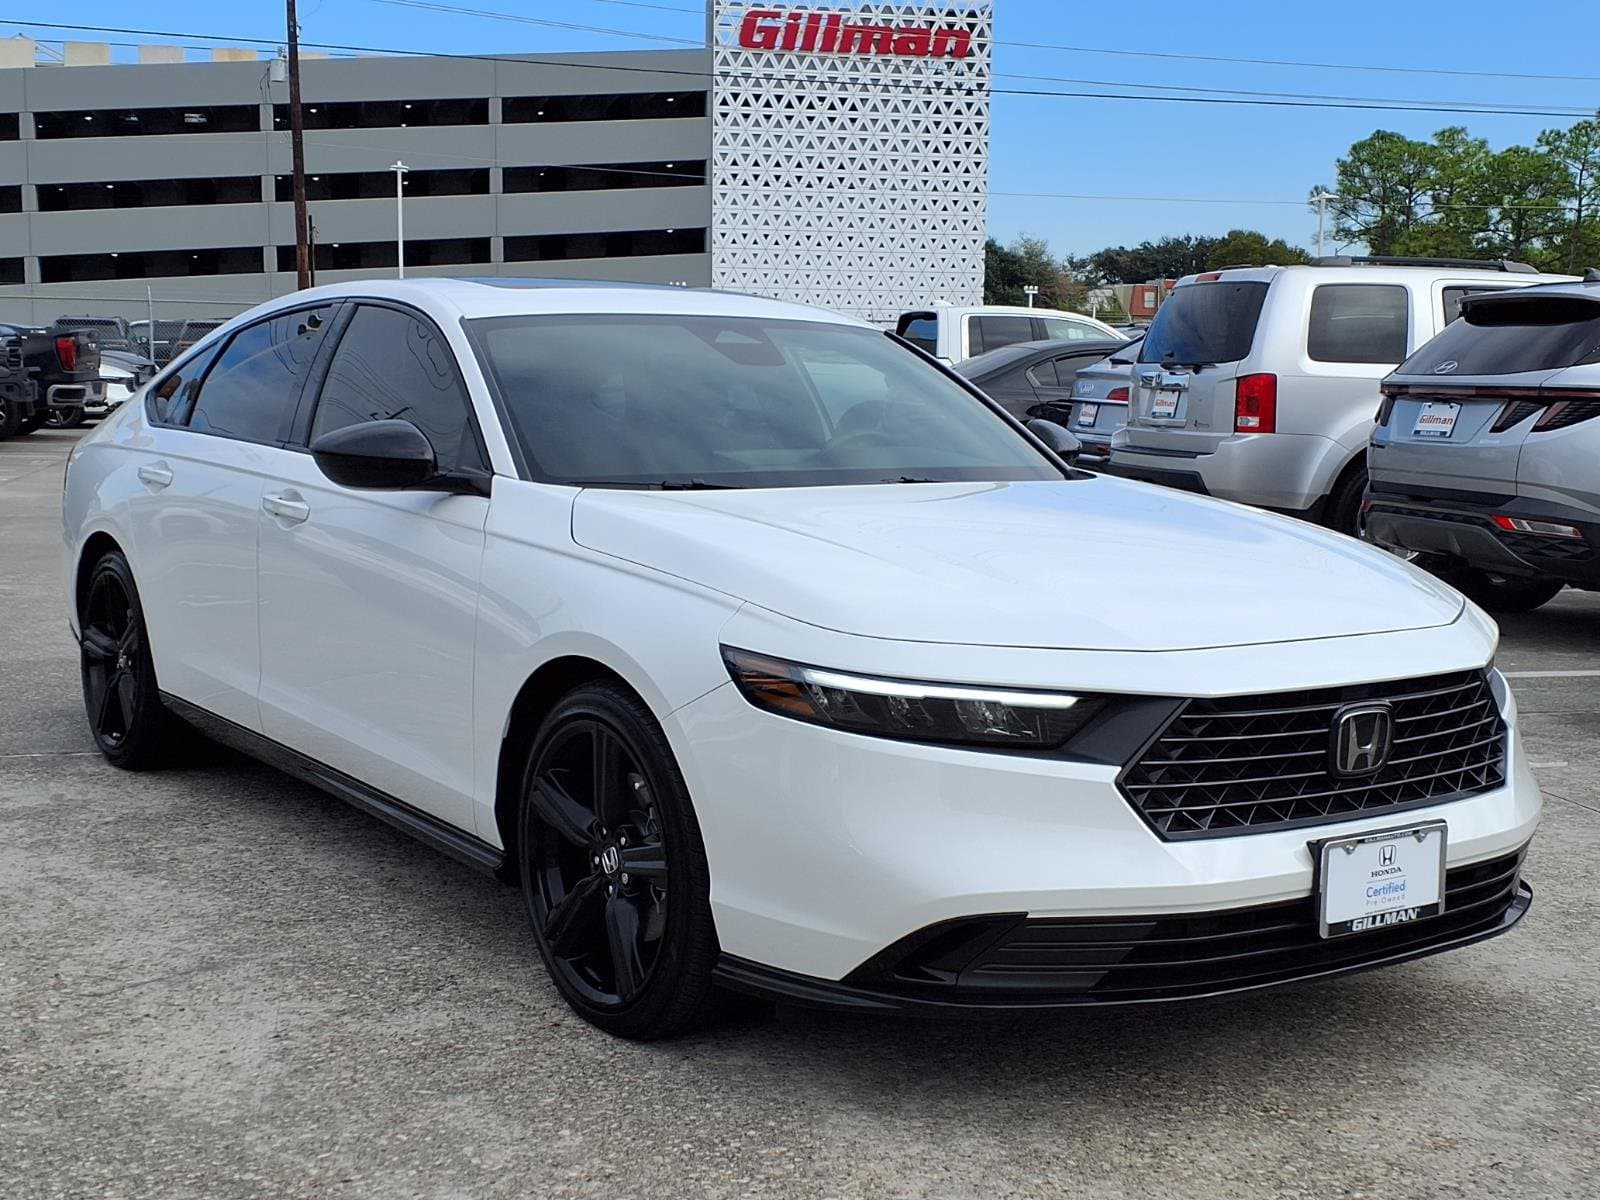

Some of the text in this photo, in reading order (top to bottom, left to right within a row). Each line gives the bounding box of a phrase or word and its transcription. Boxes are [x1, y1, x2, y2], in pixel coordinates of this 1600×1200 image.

[739, 10, 971, 58] Gillman
[1419, 414, 1453, 425] Gillman
[1371, 867, 1402, 878] HONDA
[1366, 880, 1405, 898] Certified
[1352, 908, 1418, 931] GILLMAN
